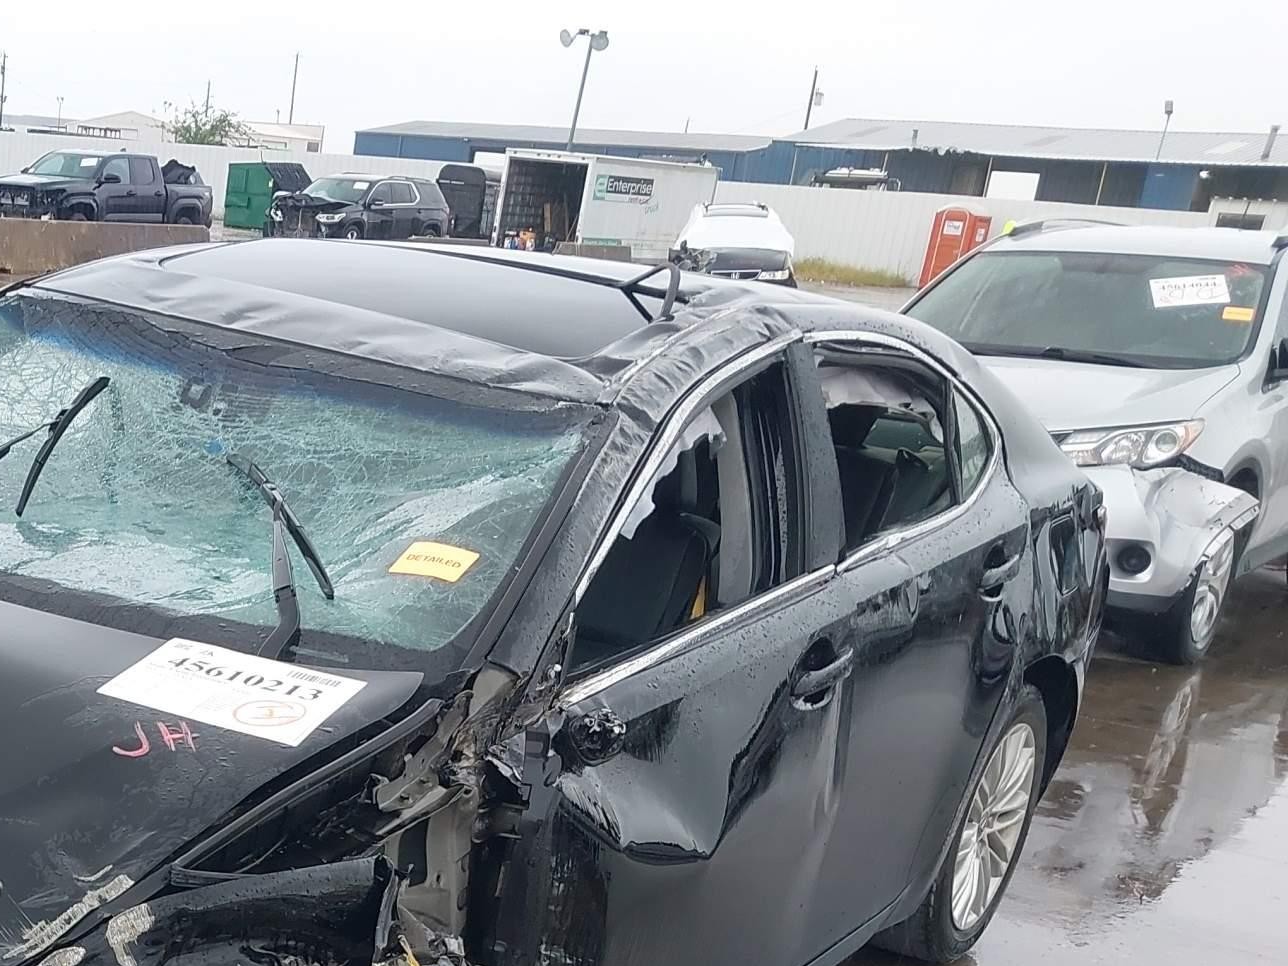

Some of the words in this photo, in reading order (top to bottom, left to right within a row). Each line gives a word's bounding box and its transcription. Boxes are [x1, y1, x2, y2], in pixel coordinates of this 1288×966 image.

[607, 178, 653, 194] Enterprise
[406, 554, 462, 569] DETAILED
[167, 657, 324, 701] 45610213
